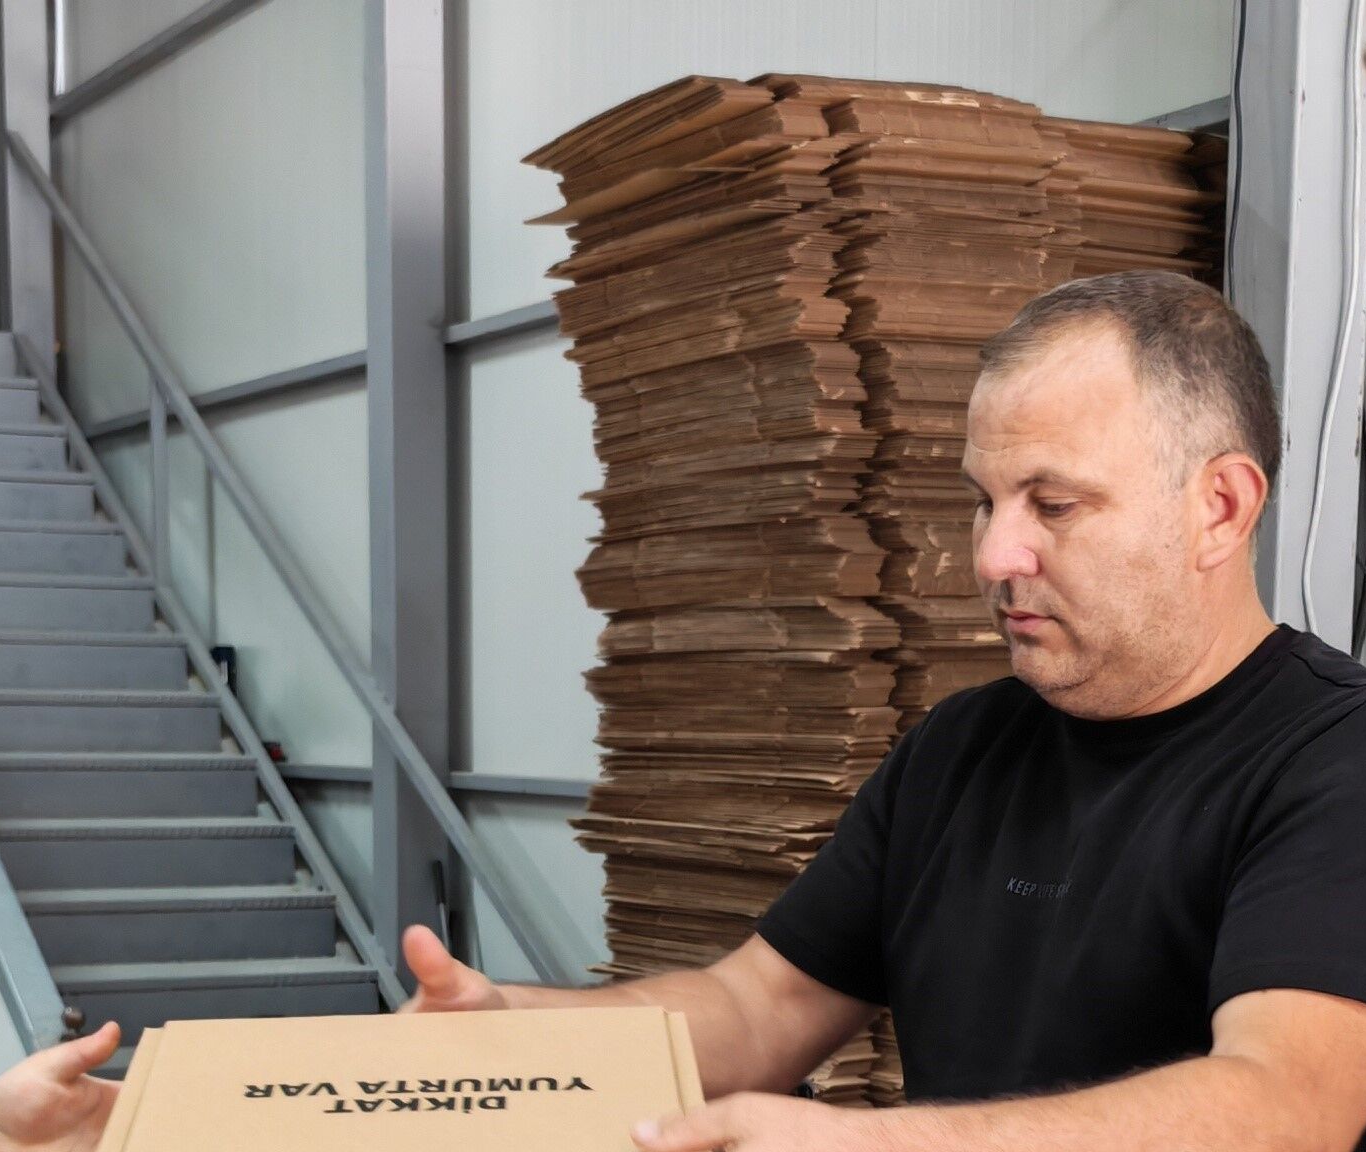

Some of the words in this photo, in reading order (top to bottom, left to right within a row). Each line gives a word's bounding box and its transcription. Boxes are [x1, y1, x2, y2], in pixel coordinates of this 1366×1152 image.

[244, 1082, 339, 1098] VAR
[356, 1077, 593, 1094] YUMURTA
[323, 1096, 507, 1114] DİKKAT
